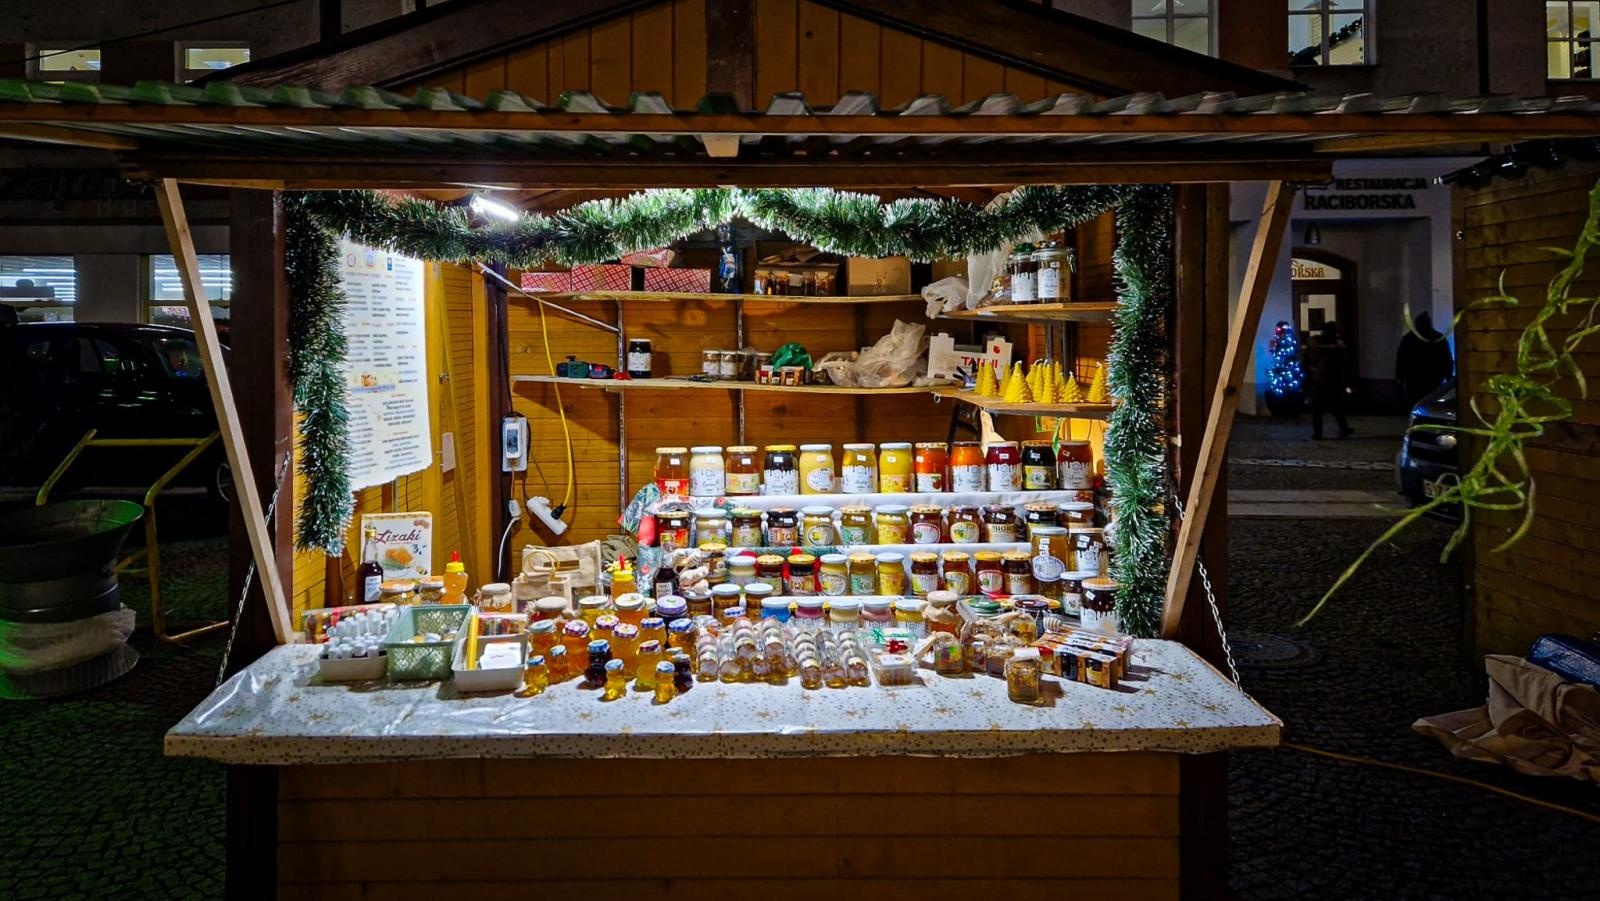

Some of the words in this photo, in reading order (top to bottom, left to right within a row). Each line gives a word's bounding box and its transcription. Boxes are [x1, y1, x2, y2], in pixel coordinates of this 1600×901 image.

[1336, 178, 1428, 190] RESTAURACJA
[1305, 194, 1416, 210] RACIBORSKA
[375, 528, 420, 544] Lizaki
